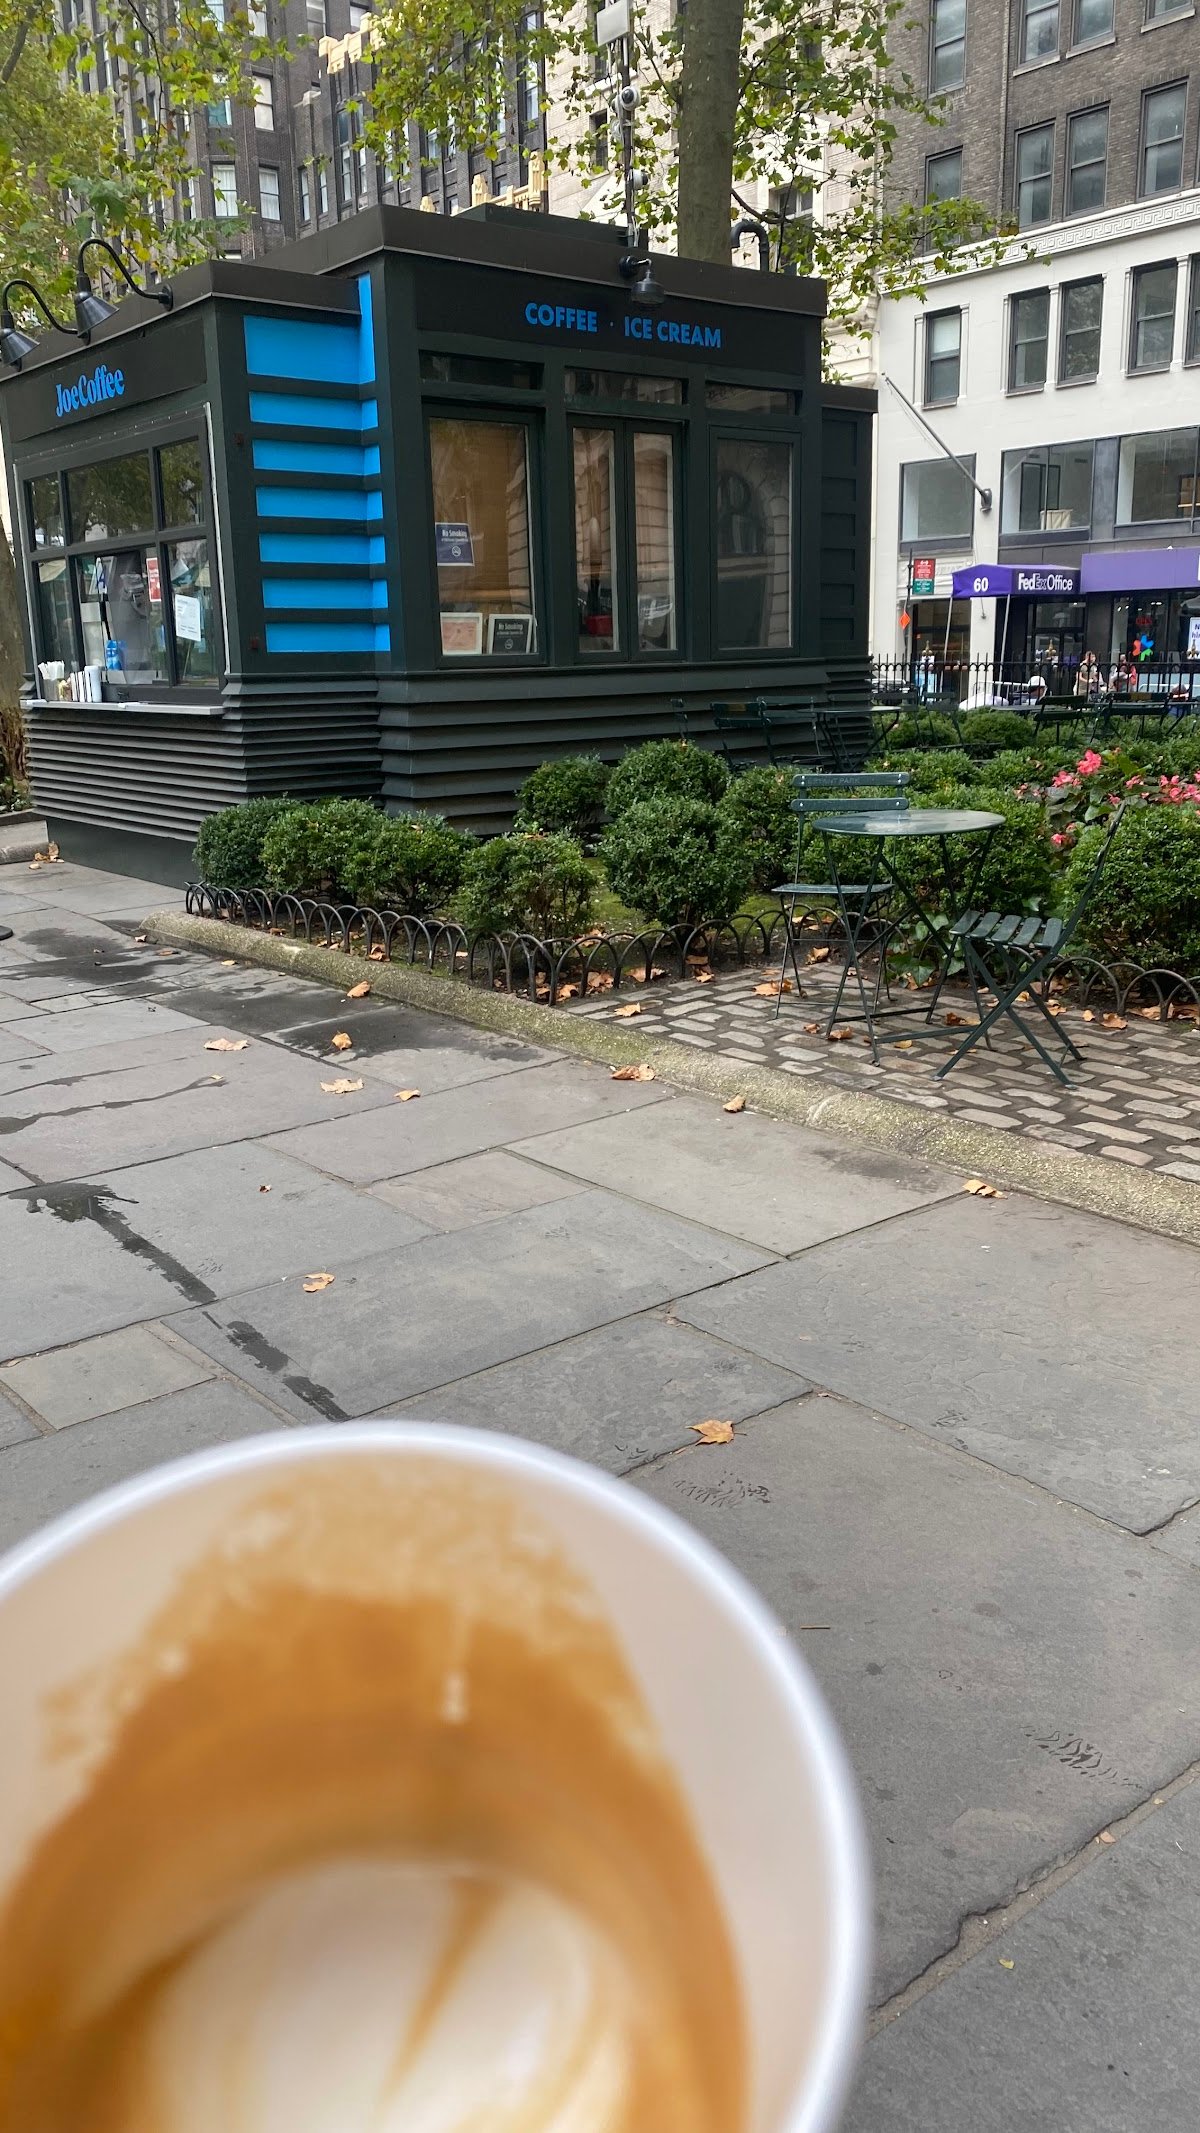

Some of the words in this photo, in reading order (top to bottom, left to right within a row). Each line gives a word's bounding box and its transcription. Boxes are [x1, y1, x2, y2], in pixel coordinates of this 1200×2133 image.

[525, 302, 597, 333] COFFEE
[624, 316, 653, 340] ICE
[657, 320, 721, 348] CREAM
[56, 364, 125, 418] JoeCoffee
[973, 577, 989, 592] 60
[1018, 572, 1047, 590] FedEx
[1047, 574, 1073, 591] Office
